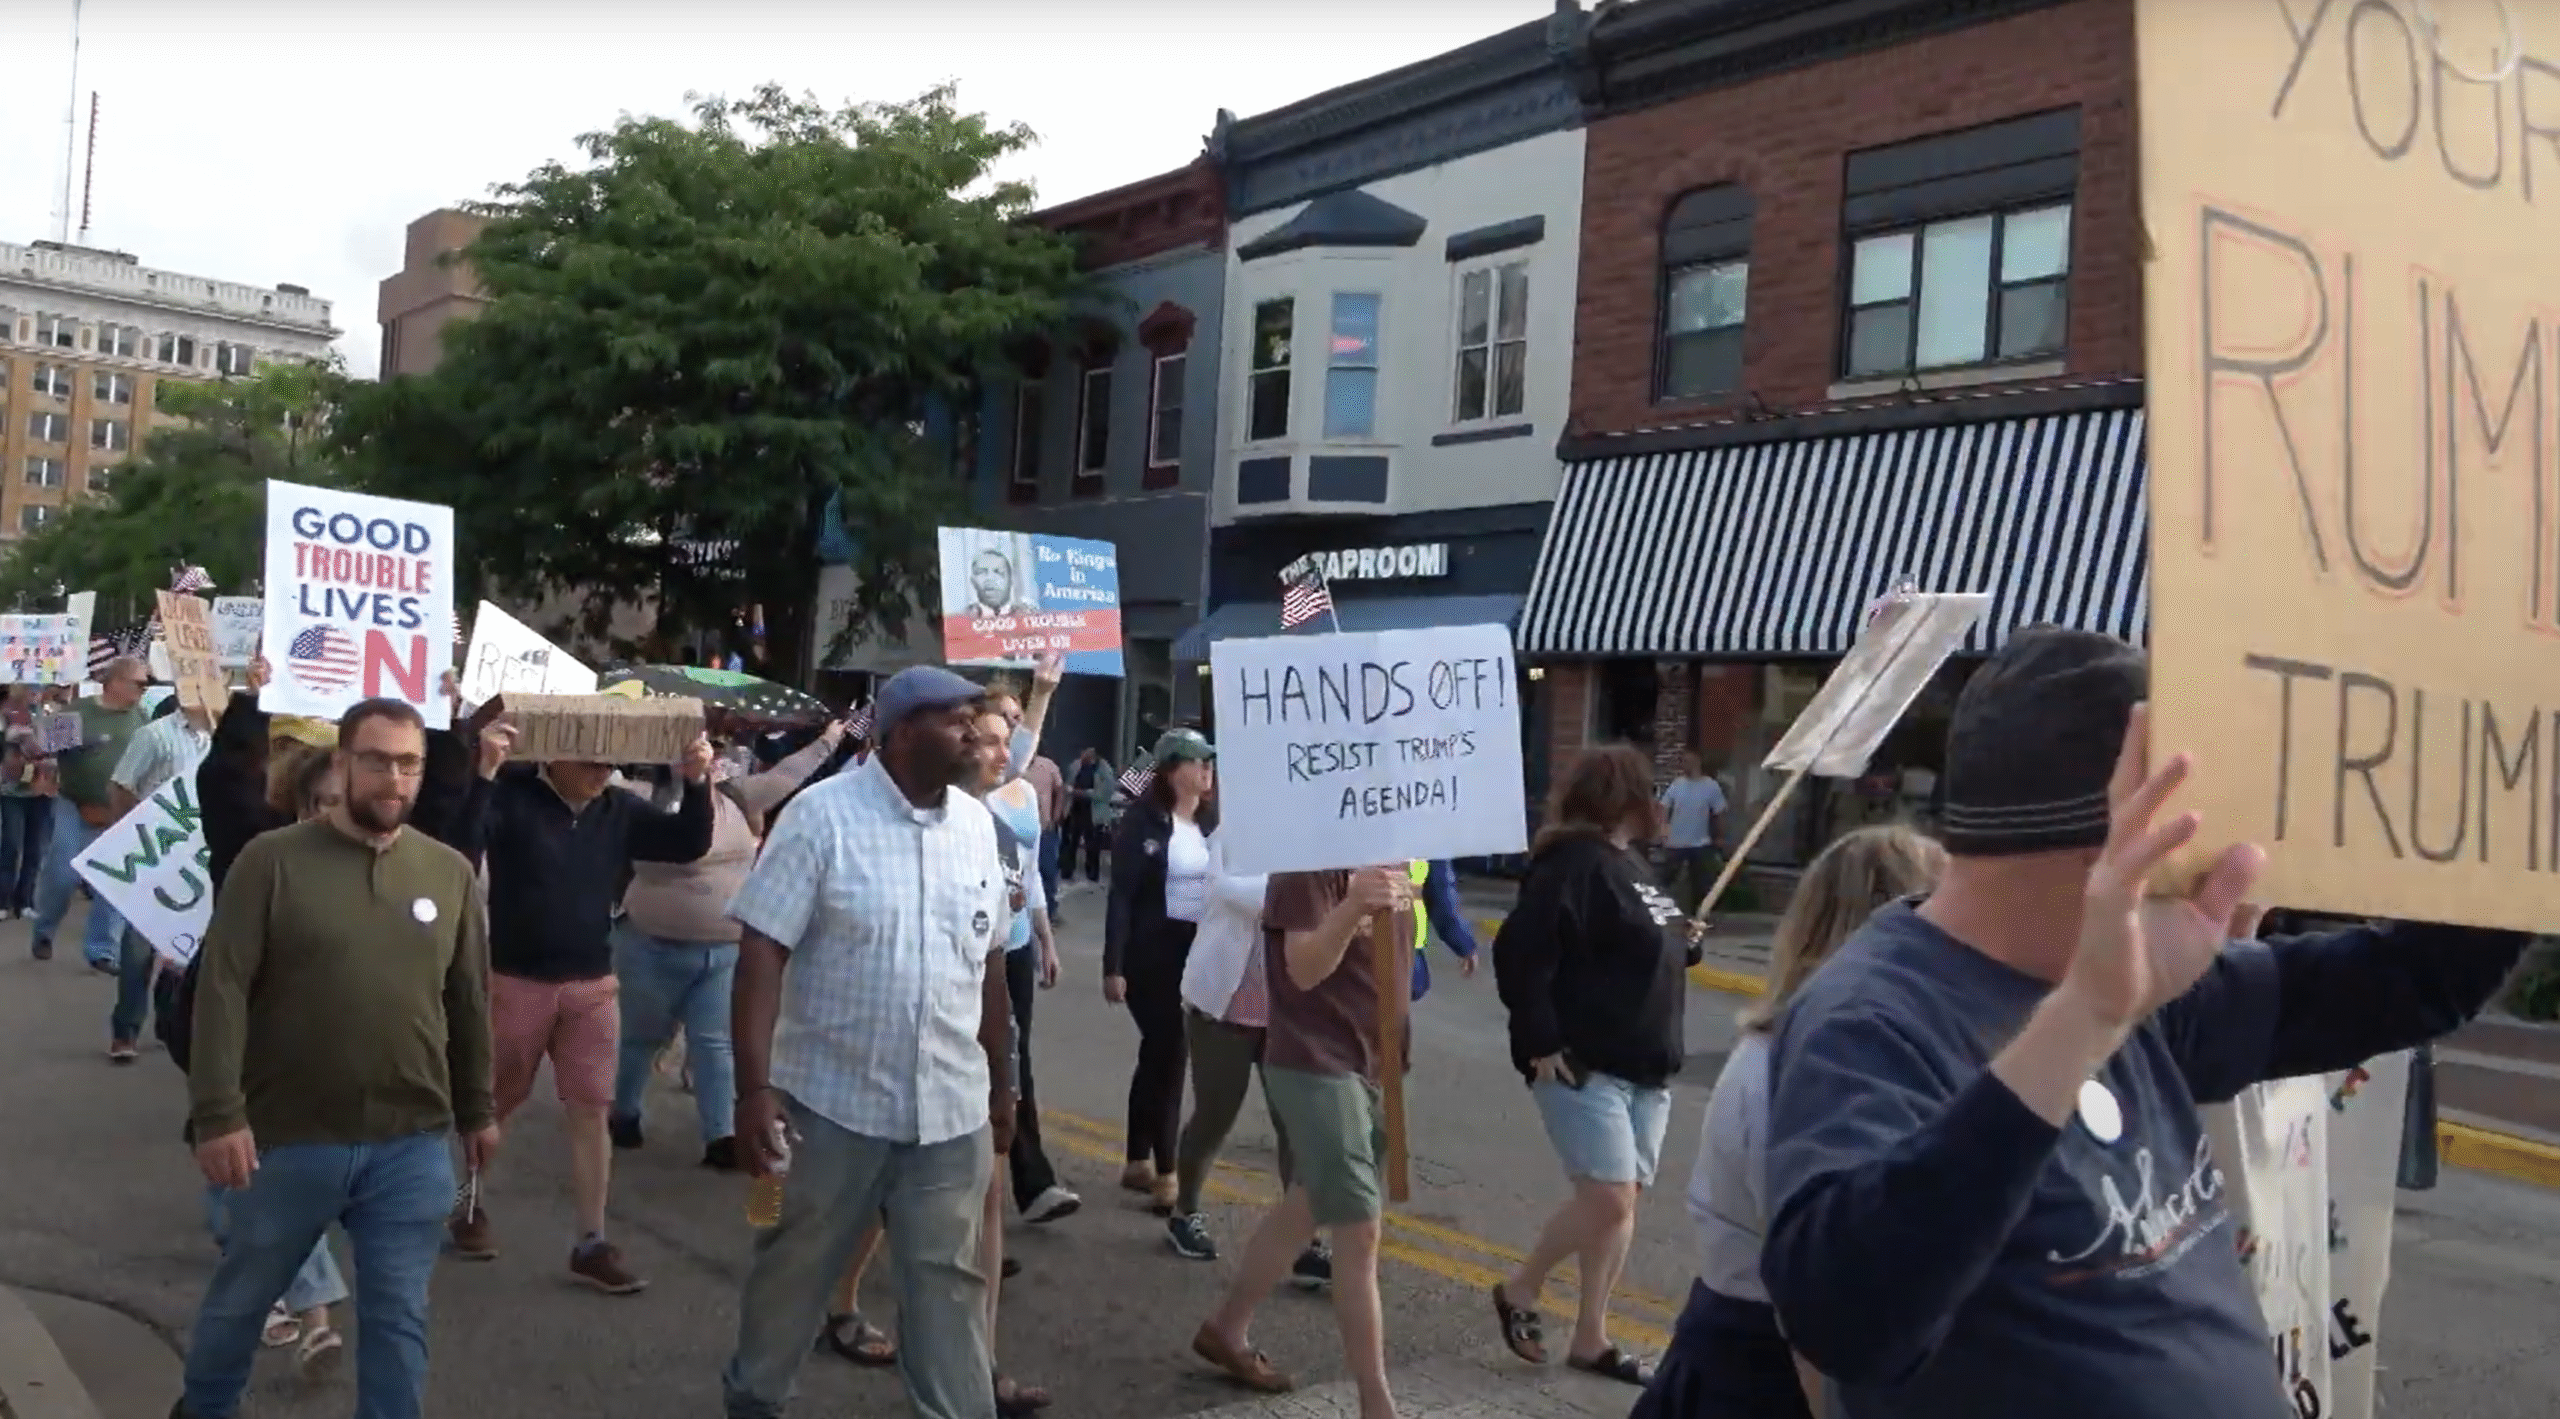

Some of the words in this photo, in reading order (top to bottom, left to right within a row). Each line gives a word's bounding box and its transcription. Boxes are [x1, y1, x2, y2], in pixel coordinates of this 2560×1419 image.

[292, 507, 431, 555] GOOD
[293, 541, 432, 595] TROUBLE
[1311, 543, 1448, 580] TAPROOM
[300, 583, 422, 630] LIVES
[1240, 661, 1415, 726] HANDS
[1427, 655, 1506, 710] OFF!
[1287, 742, 1380, 783] RESIST
[2244, 652, 2560, 873] TRUM
[1338, 774, 1457, 820] AGENDA!
[86, 775, 202, 884] WAK
